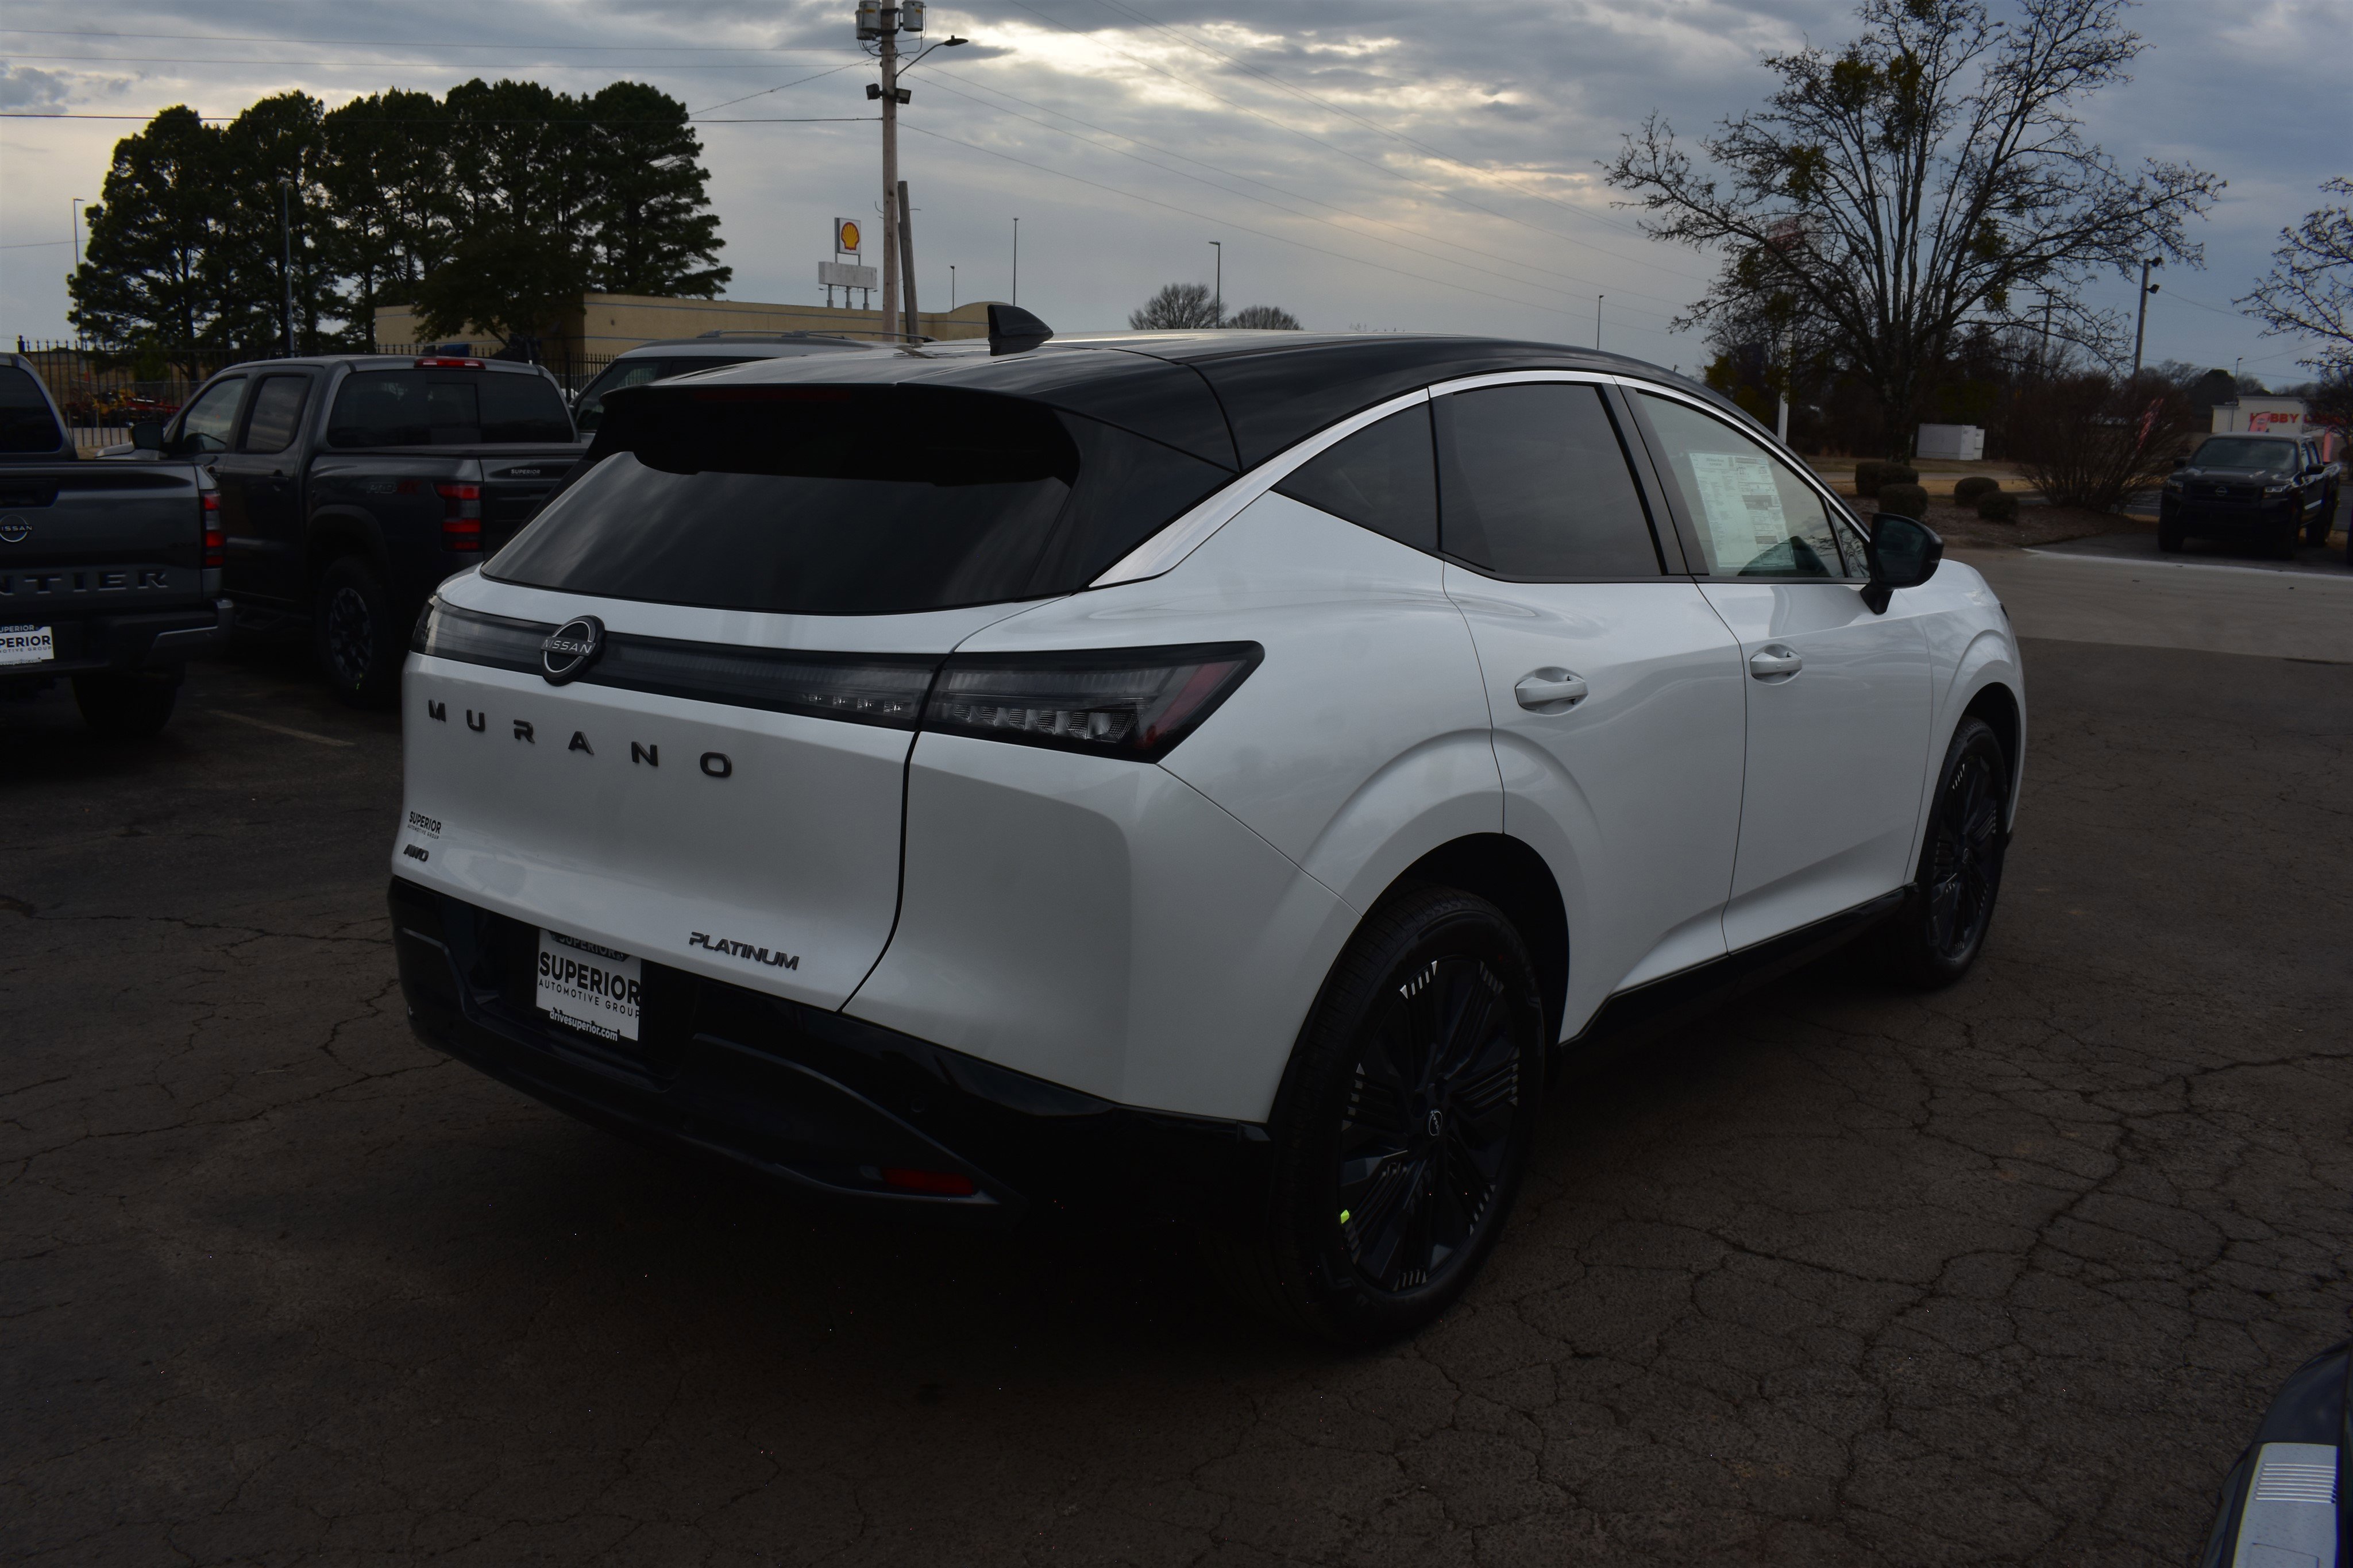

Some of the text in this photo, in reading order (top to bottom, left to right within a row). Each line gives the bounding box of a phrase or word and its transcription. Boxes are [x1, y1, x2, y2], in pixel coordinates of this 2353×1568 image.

[2250, 412, 2300, 423] HBBY
[542, 639, 593, 654] NISSAN
[428, 698, 732, 778] MURANO
[409, 811, 442, 834] SUPERIOR
[403, 844, 429, 862] AWD
[689, 931, 800, 971] PLATINUM
[539, 951, 641, 1006] SUPERIOR
[538, 978, 641, 1019] AUTOMOTIVE GROUP
[549, 1008, 619, 1042] drivesuperior.com
